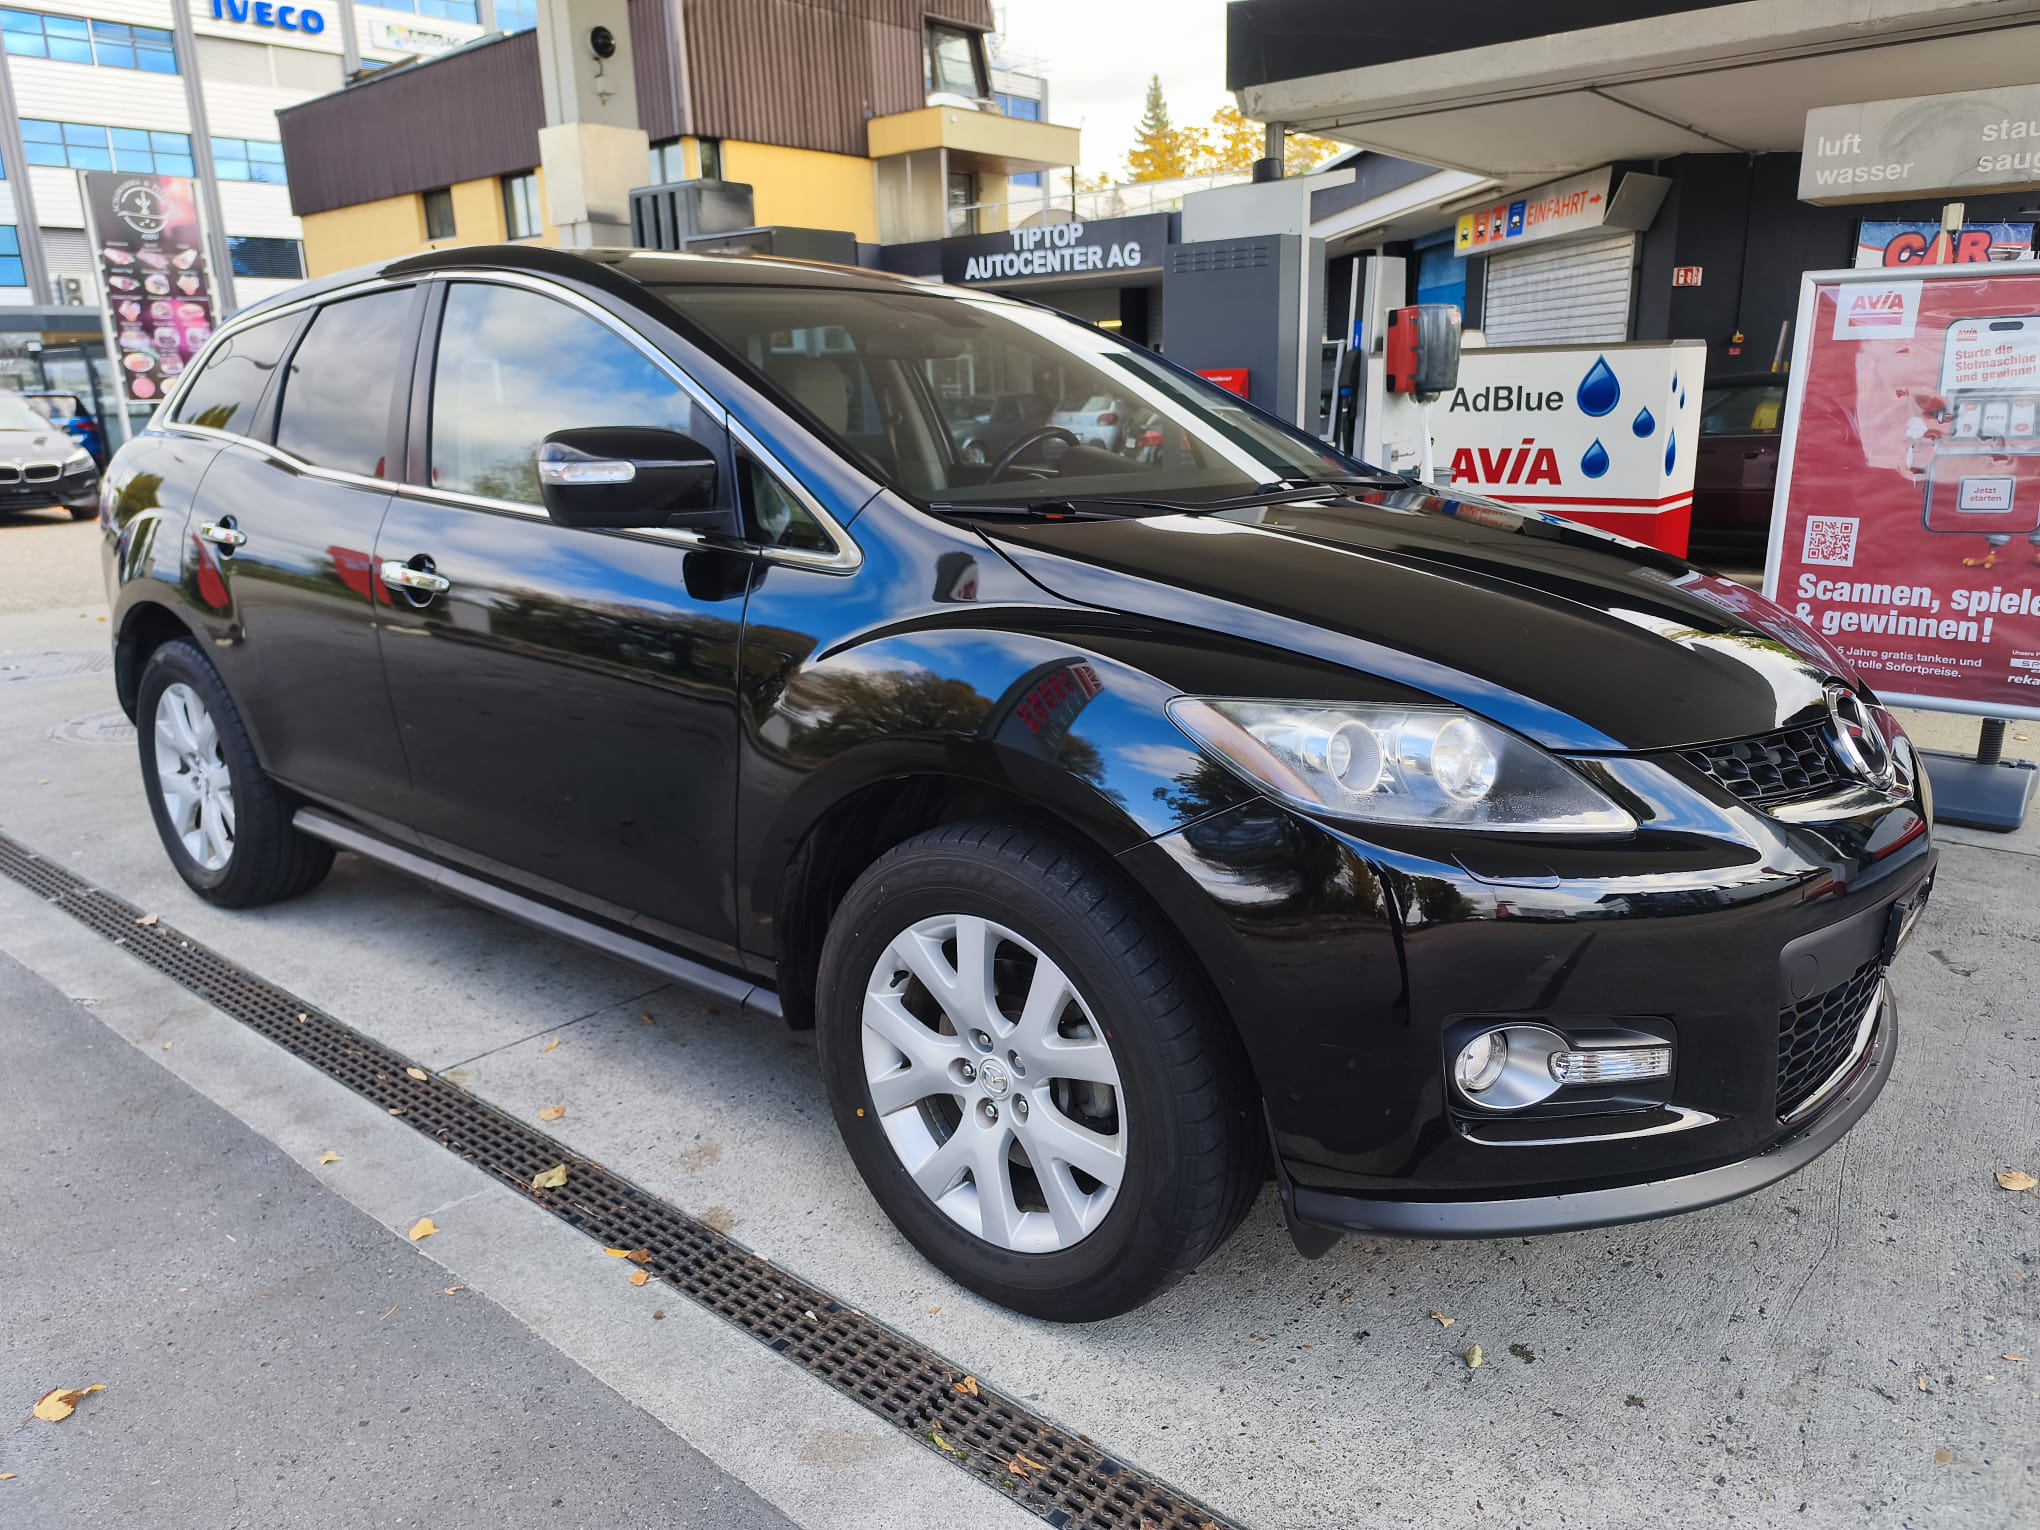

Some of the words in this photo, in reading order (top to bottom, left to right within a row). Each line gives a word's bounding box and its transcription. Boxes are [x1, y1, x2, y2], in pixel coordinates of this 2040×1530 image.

[213, 0, 325, 35] IVECO
[1817, 133, 1862, 157] luft
[1816, 162, 1914, 185] wasser
[1526, 190, 1589, 227] EINFAHRT
[1010, 222, 1084, 250] TIPTOP
[965, 245, 1103, 280] AUTOCENTER
[1107, 242, 1141, 268] AG
[1883, 230, 1992, 268] CAR
[1851, 290, 1904, 310] AVIA
[1955, 348, 1991, 360] Starte
[1995, 345, 2013, 355] die
[1955, 354, 2036, 371] Slotmaschine
[1955, 373, 1977, 382] und
[1982, 365, 2036, 382] gewinne!
[1449, 386, 1564, 413] AdBlue
[1451, 437, 1562, 485] AVIA
[1797, 573, 1940, 614] Scannen,
[1795, 602, 1814, 627] &
[1822, 609, 1994, 643] gewinnen!
[1847, 647, 1878, 657] Jahre
[1881, 650, 1914, 661] gratis
[1917, 653, 1956, 665] tanken
[1959, 658, 1982, 668] und
[1858, 660, 1882, 670] tolle
[1886, 661, 1961, 678] Sofortpreise.
[2008, 674, 2040, 685] reka
